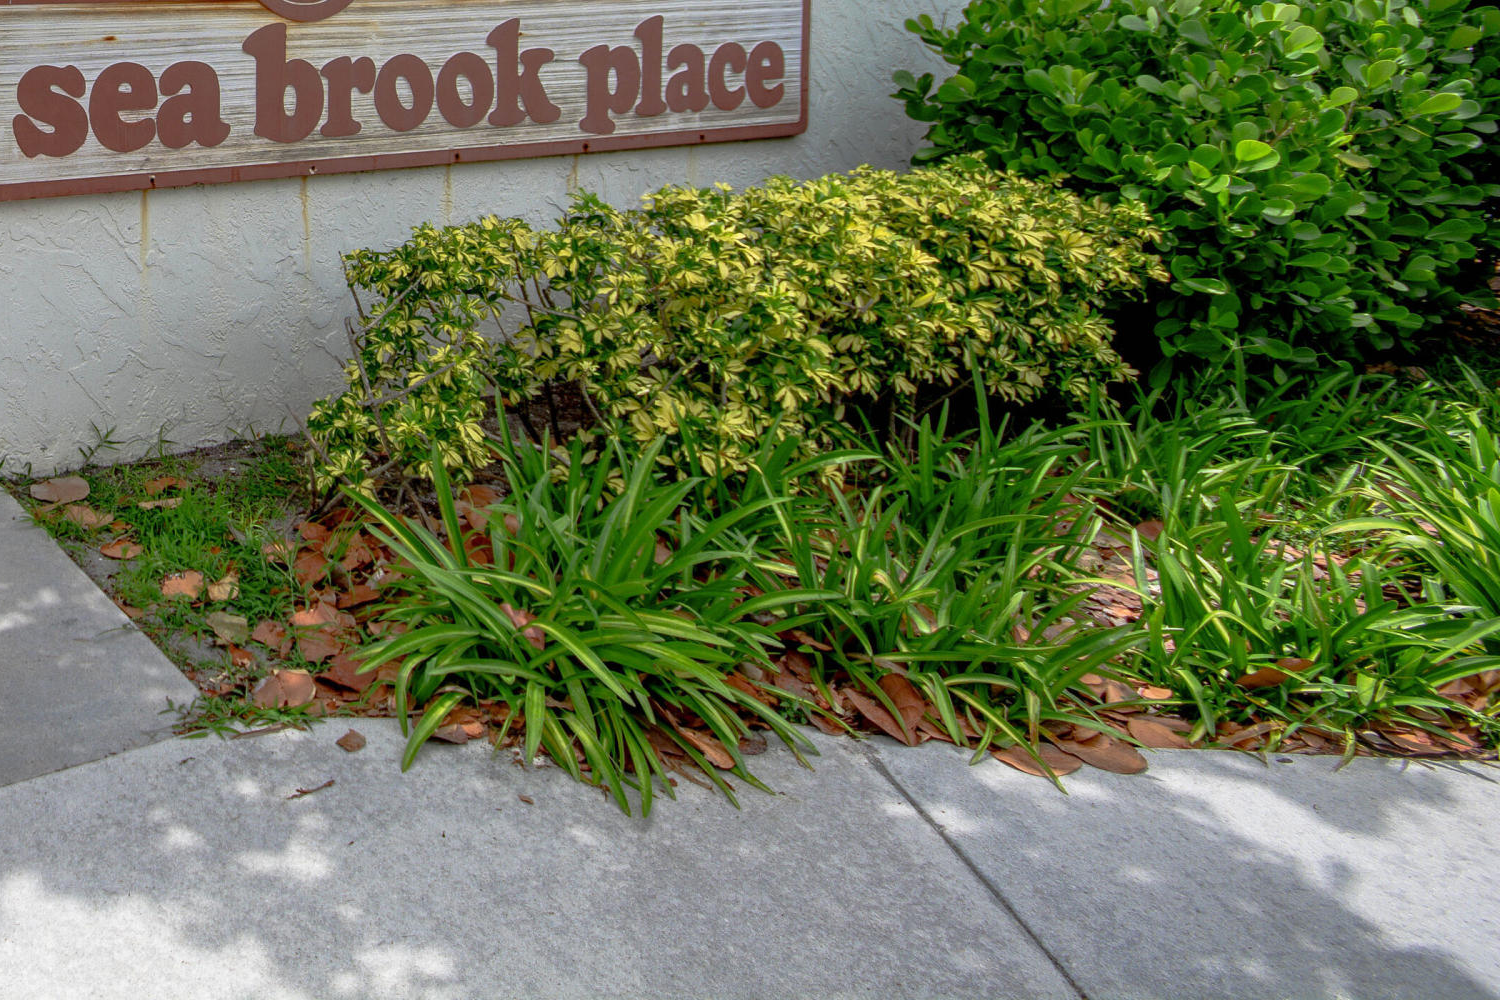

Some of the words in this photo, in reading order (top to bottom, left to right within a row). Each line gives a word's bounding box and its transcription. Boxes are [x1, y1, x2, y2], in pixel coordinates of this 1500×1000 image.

[13, 61, 231, 158] sea
[242, 17, 561, 143] brook
[579, 15, 785, 135] place
